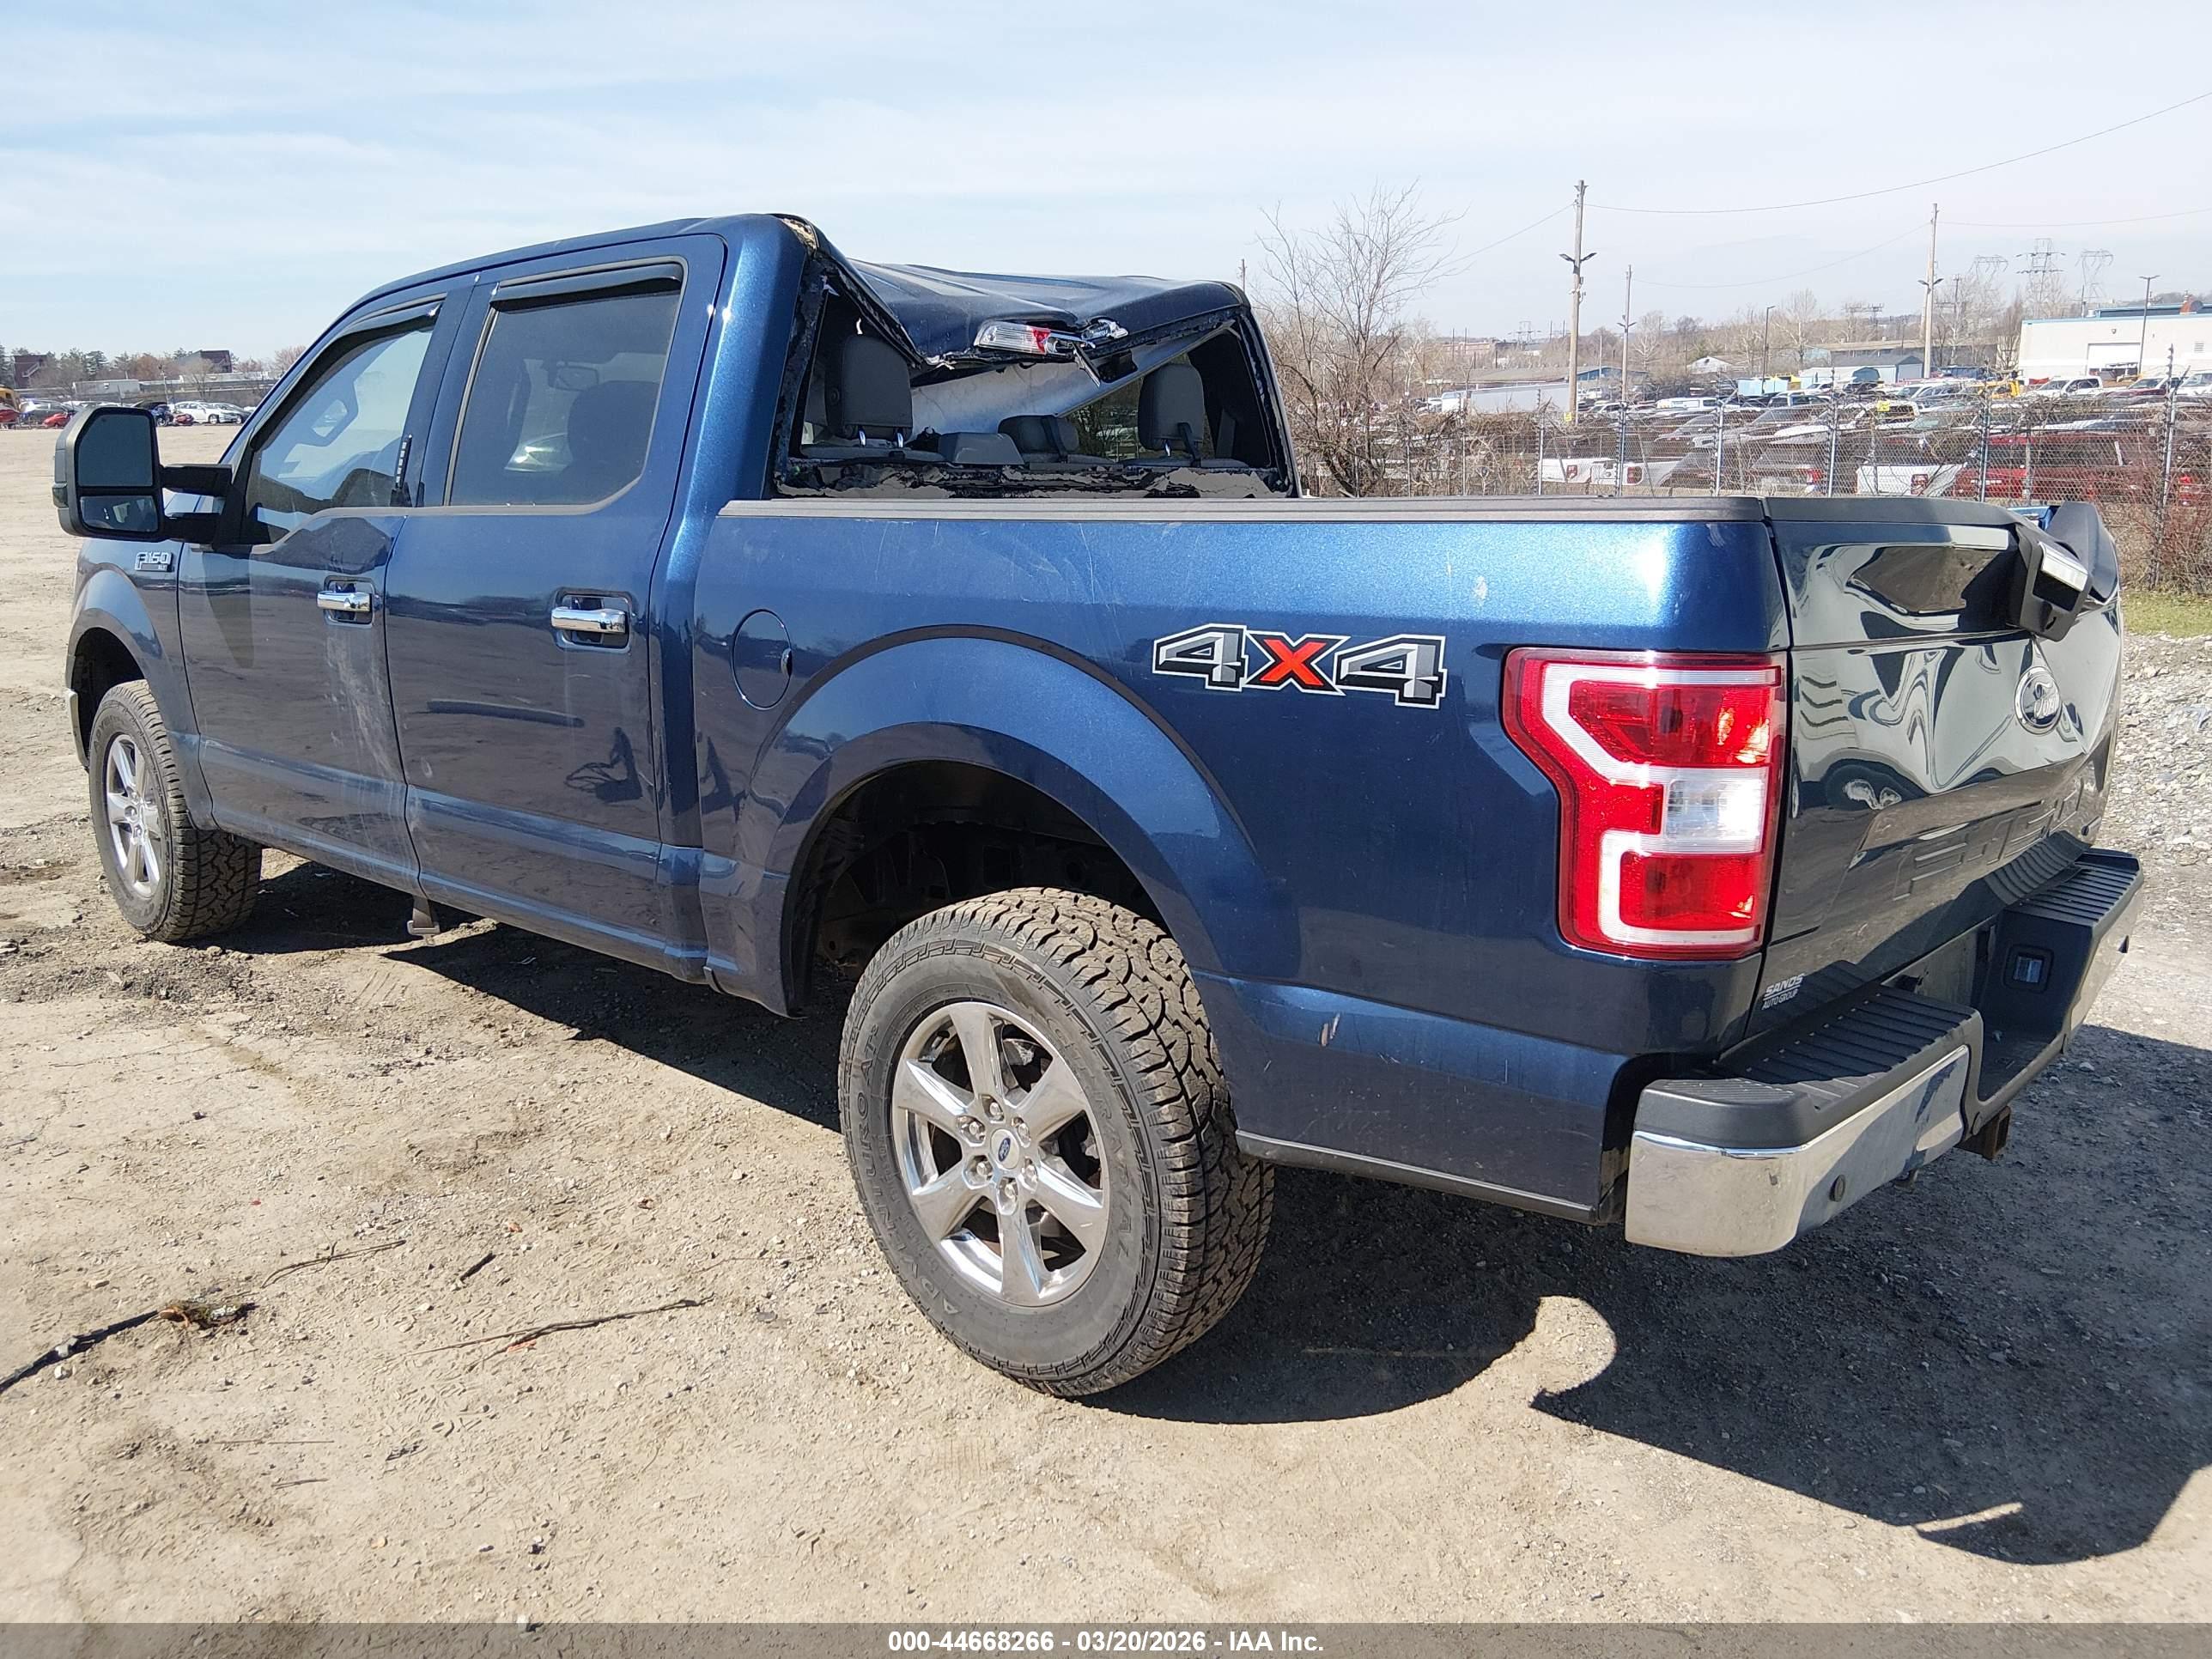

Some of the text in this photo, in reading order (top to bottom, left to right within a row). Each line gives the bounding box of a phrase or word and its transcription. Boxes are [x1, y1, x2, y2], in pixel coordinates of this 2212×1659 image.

[1765, 973, 1805, 997] SANDS
[1761, 988, 1799, 1011] AUTO GROUP
[855, 1088, 961, 1316] ADVENTURO
